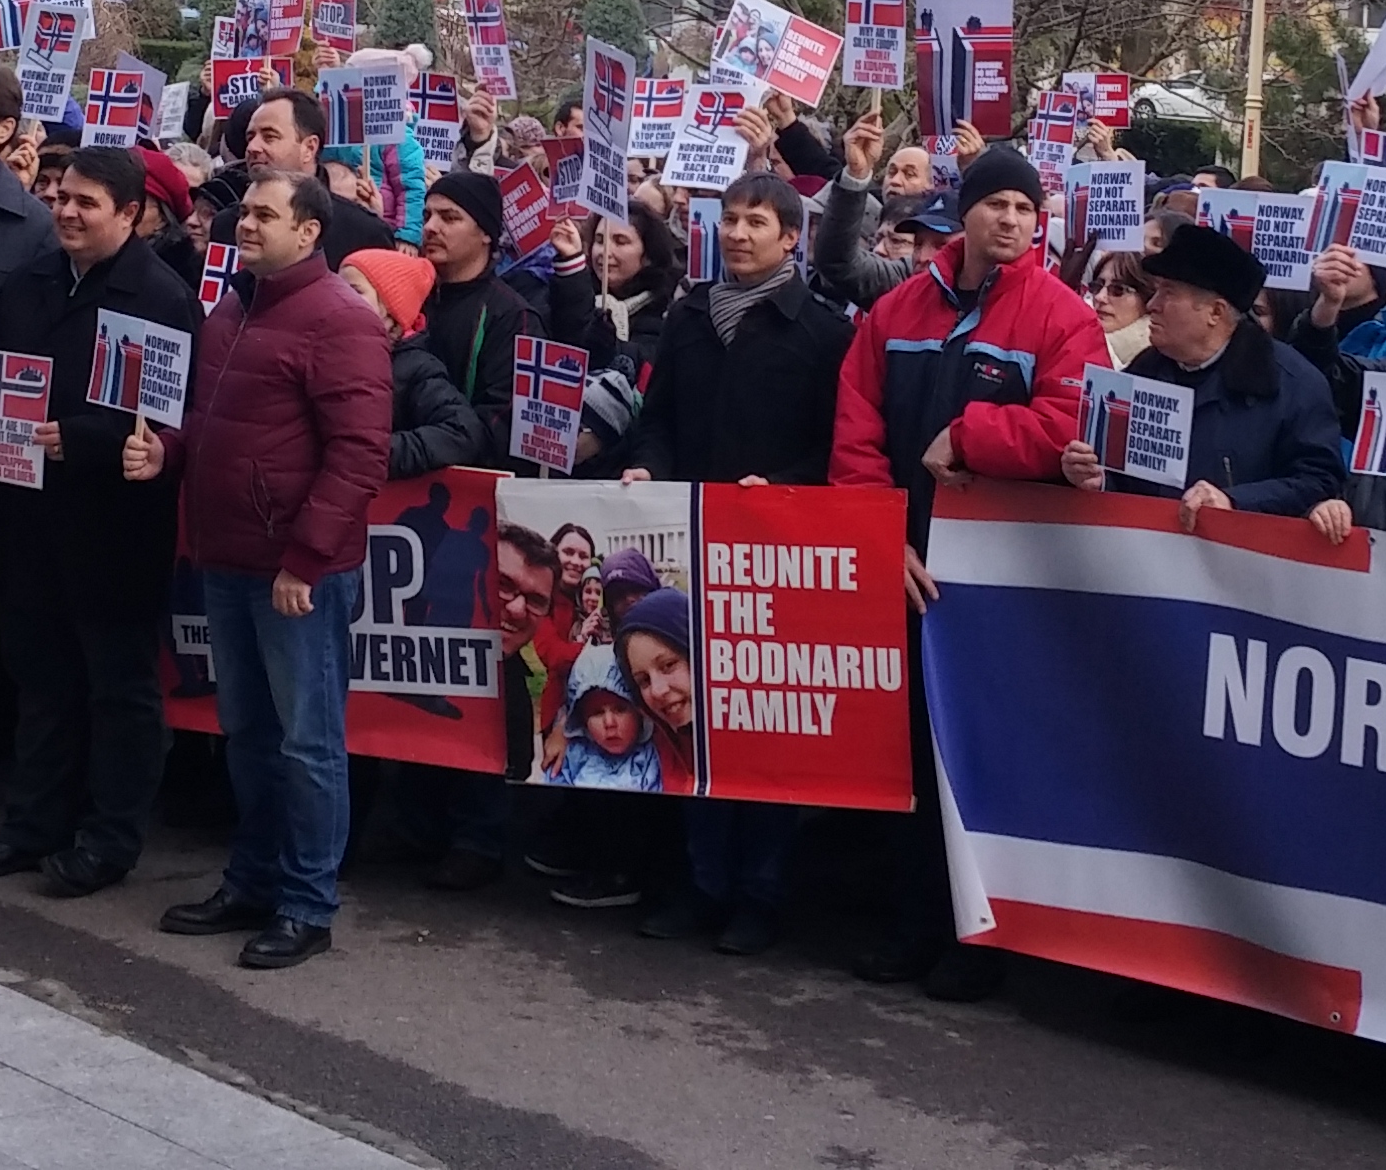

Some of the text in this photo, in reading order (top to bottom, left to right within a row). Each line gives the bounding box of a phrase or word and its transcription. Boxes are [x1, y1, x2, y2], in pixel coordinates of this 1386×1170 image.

[782, 39, 801, 56] THE
[364, 87, 392, 100] DO NOT
[364, 99, 401, 111] SEPARATE
[365, 111, 404, 123] BODNARIU
[431, 138, 454, 150] CHILD
[635, 131, 654, 140] STOP
[716, 145, 736, 155] GIVE
[676, 153, 735, 166] THE CHILDREN
[683, 163, 720, 173] BACK TO
[670, 171, 695, 181] THEIR
[1091, 172, 1132, 185] NORWAY,
[1090, 187, 1123, 198] DO NOT
[1361, 193, 1376, 206] DO
[1089, 200, 1136, 212] SEPARATE
[1258, 204, 1304, 221] NORWAY,
[1088, 214, 1140, 226] BODNARIU
[1256, 219, 1295, 234] DO NOT
[1254, 248, 1309, 265] BODNARIU
[1265, 263, 1292, 278] MILY!
[144, 334, 181, 358] NORWAY,
[144, 349, 174, 368] DO NOT
[142, 363, 182, 387] SEPARATE
[141, 377, 183, 402] BODNARIU
[140, 391, 170, 413] FAMILY!
[1133, 390, 1179, 414] NORWAY,
[1132, 405, 1170, 426] DO NOT
[1130, 420, 1182, 445] SEPARATE
[1129, 435, 1184, 461] BODNARIU
[1127, 450, 1167, 473] FAMILY!
[707, 542, 858, 591] REUNITE
[707, 591, 775, 635] THE
[350, 632, 493, 687] VERNET
[710, 638, 902, 691] BODNARIU
[711, 687, 837, 736] FAMILY
